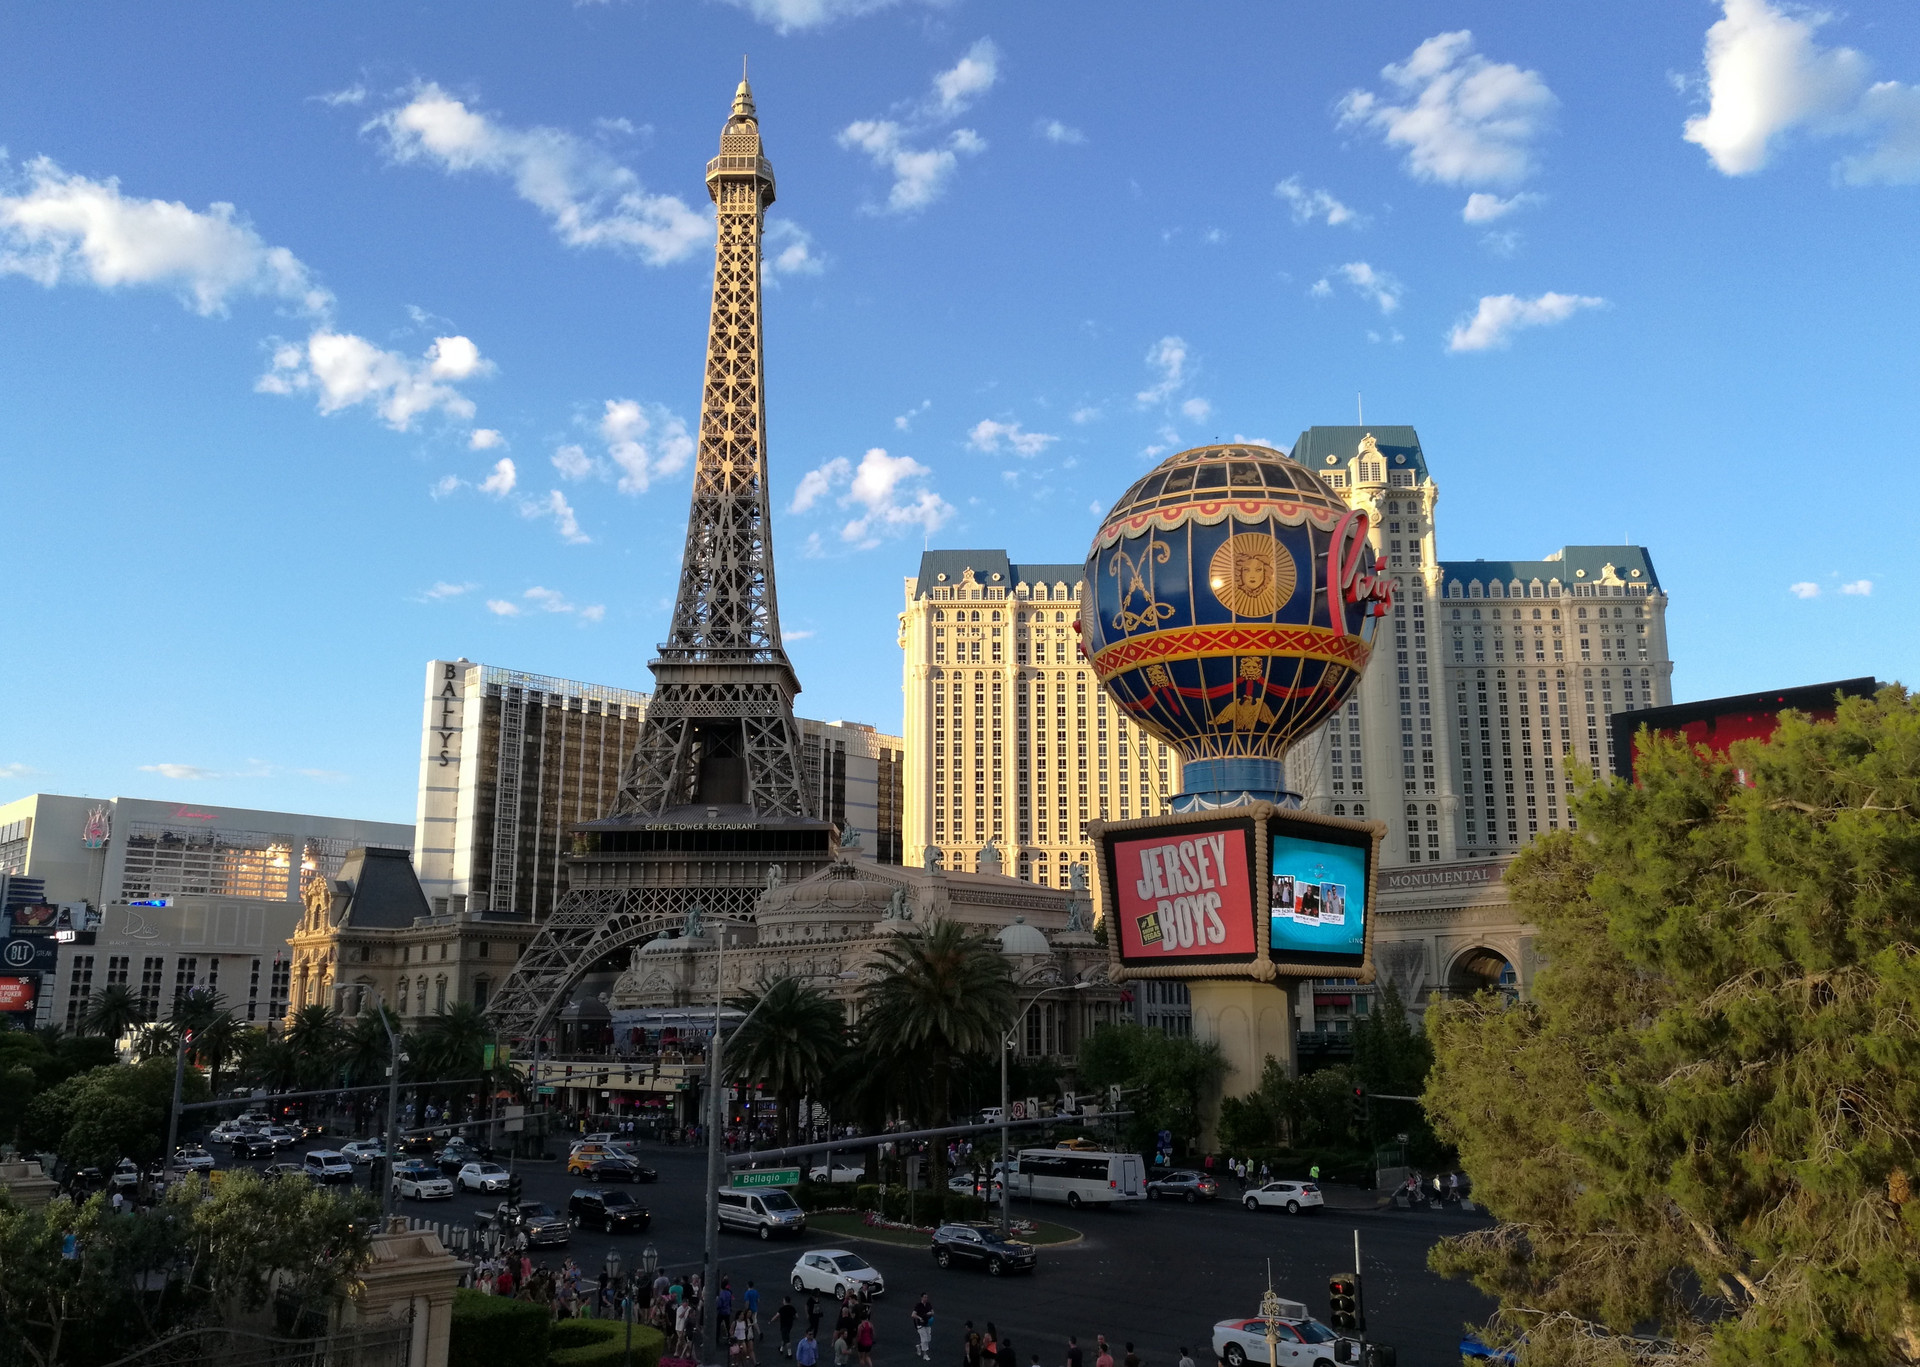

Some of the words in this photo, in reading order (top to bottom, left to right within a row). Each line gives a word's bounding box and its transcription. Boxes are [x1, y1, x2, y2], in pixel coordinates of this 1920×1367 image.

[645, 823, 673, 831] EIFFEL
[675, 822, 704, 830] TOWER
[707, 822, 758, 830] RESTAURANT
[1136, 833, 1228, 901] JERSEY
[1388, 869, 1490, 887] MONUMENTAL
[1157, 891, 1227, 952] BOYS
[1143, 931, 1161, 941] VEGAS
[11, 945, 30, 961] BLT
[743, 1173, 780, 1185] Bellagio
